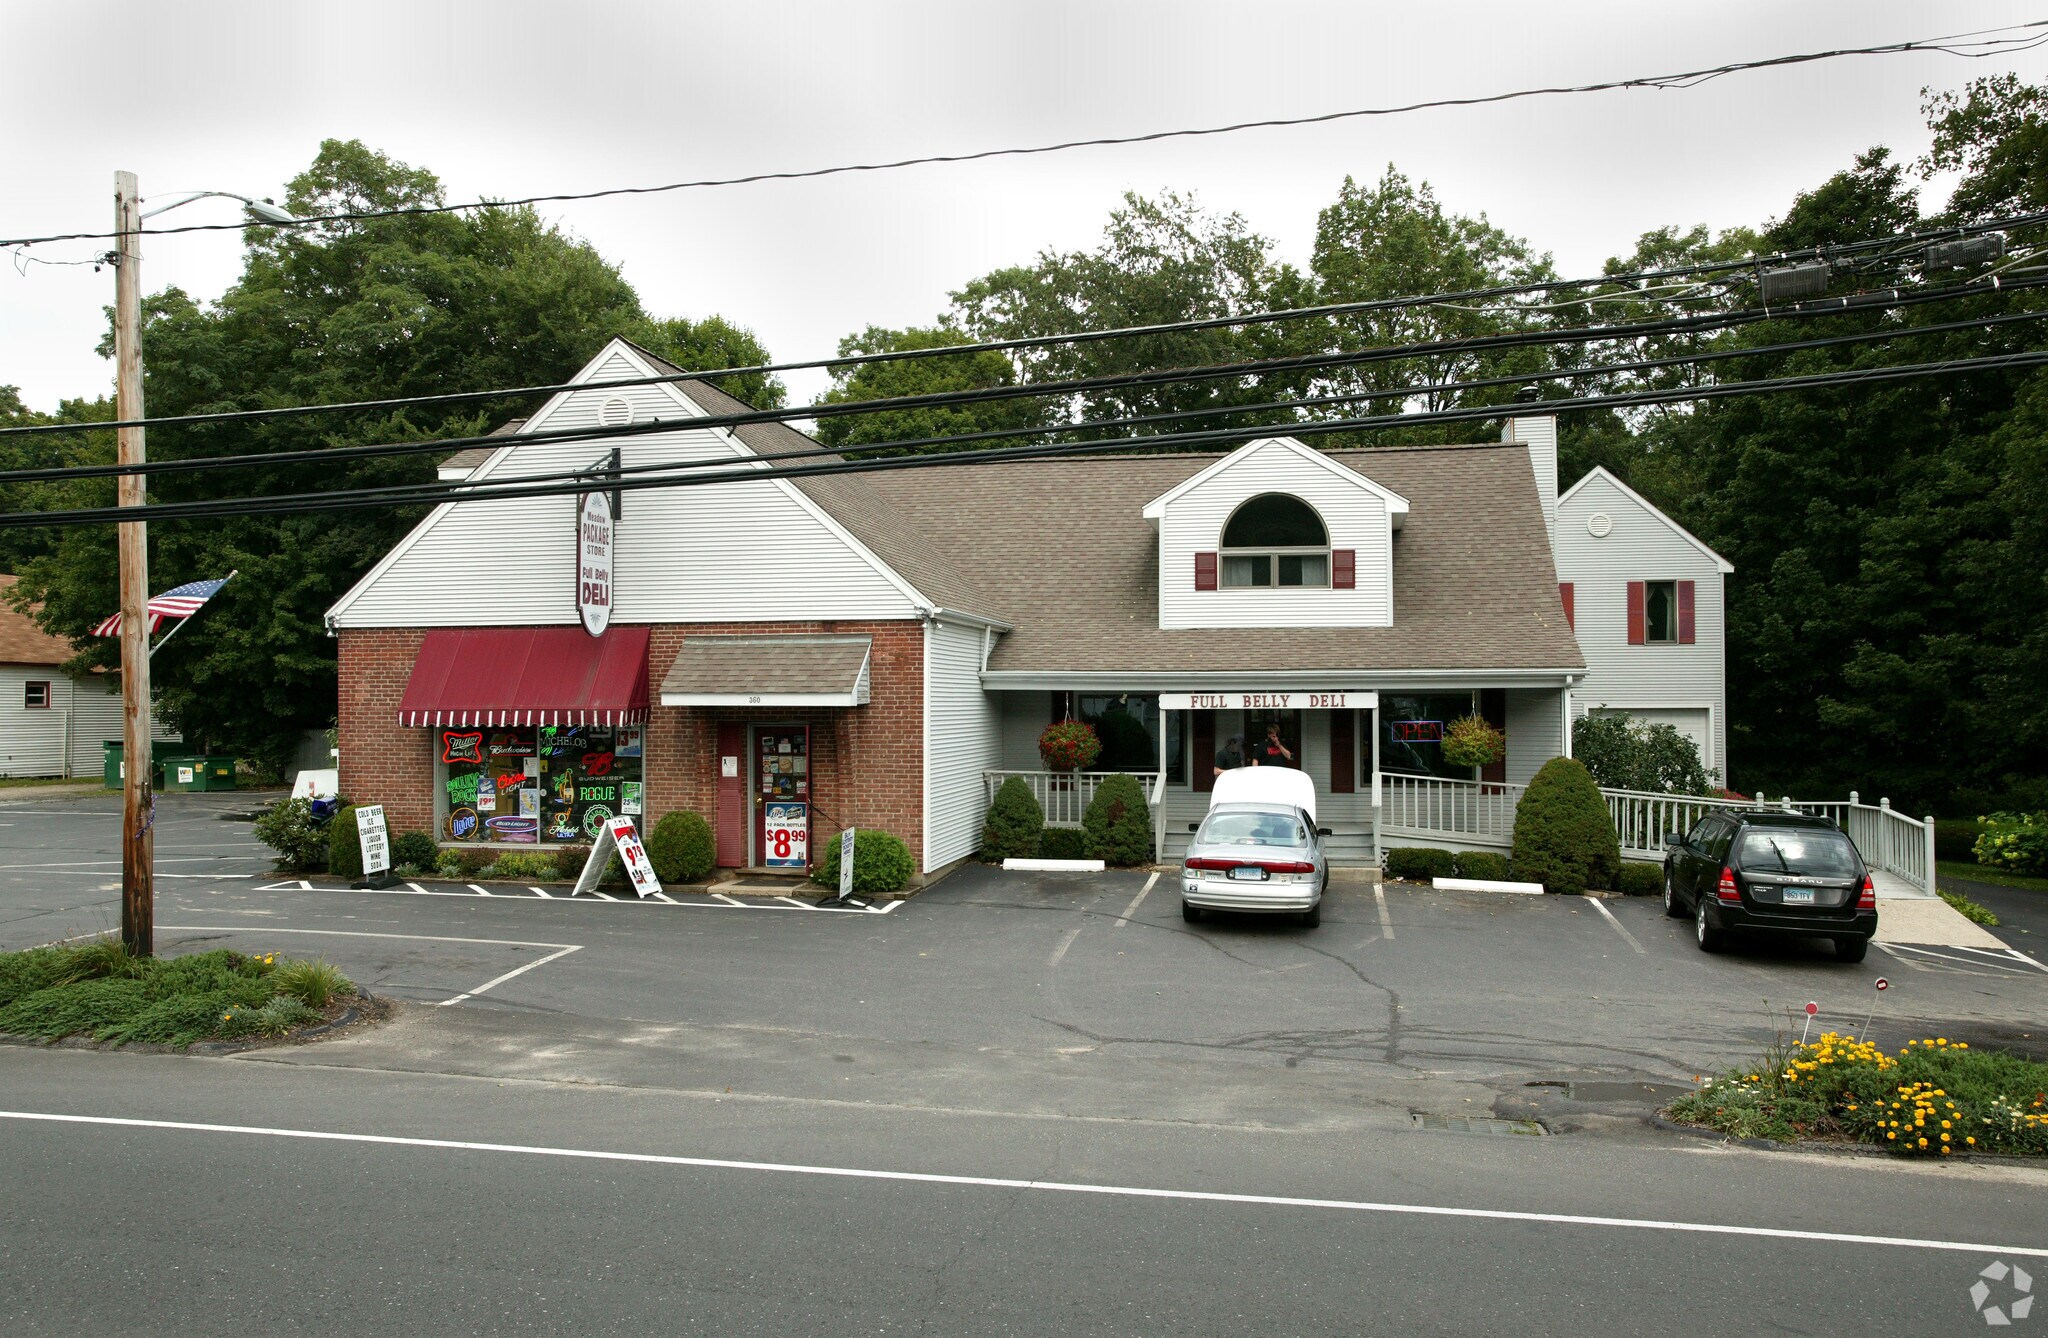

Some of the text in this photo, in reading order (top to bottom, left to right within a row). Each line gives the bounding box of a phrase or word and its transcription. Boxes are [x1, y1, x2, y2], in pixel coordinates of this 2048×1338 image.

[587, 511, 606, 523] Meadow
[583, 523, 609, 545] PACKAGE
[586, 544, 606, 557] STORE
[582, 567, 609, 583] Full Belly
[582, 582, 608, 606] DELI
[749, 696, 761, 704] 360
[1190, 694, 1346, 708] FULL BELLY DELI
[1393, 722, 1442, 740] OPEN
[449, 736, 480, 748] Miller
[489, 745, 533, 755] Budweiser
[501, 781, 526, 796] LIGHT
[580, 787, 615, 801] ROGUE
[451, 788, 479, 804] ROCK
[358, 808, 382, 818] COLD BEER
[360, 825, 385, 836] CIGARETTES
[366, 835, 381, 843] LIQUOR
[366, 843, 384, 853] LOTTERY
[370, 852, 381, 860] WINE
[371, 862, 382, 870] SODA
